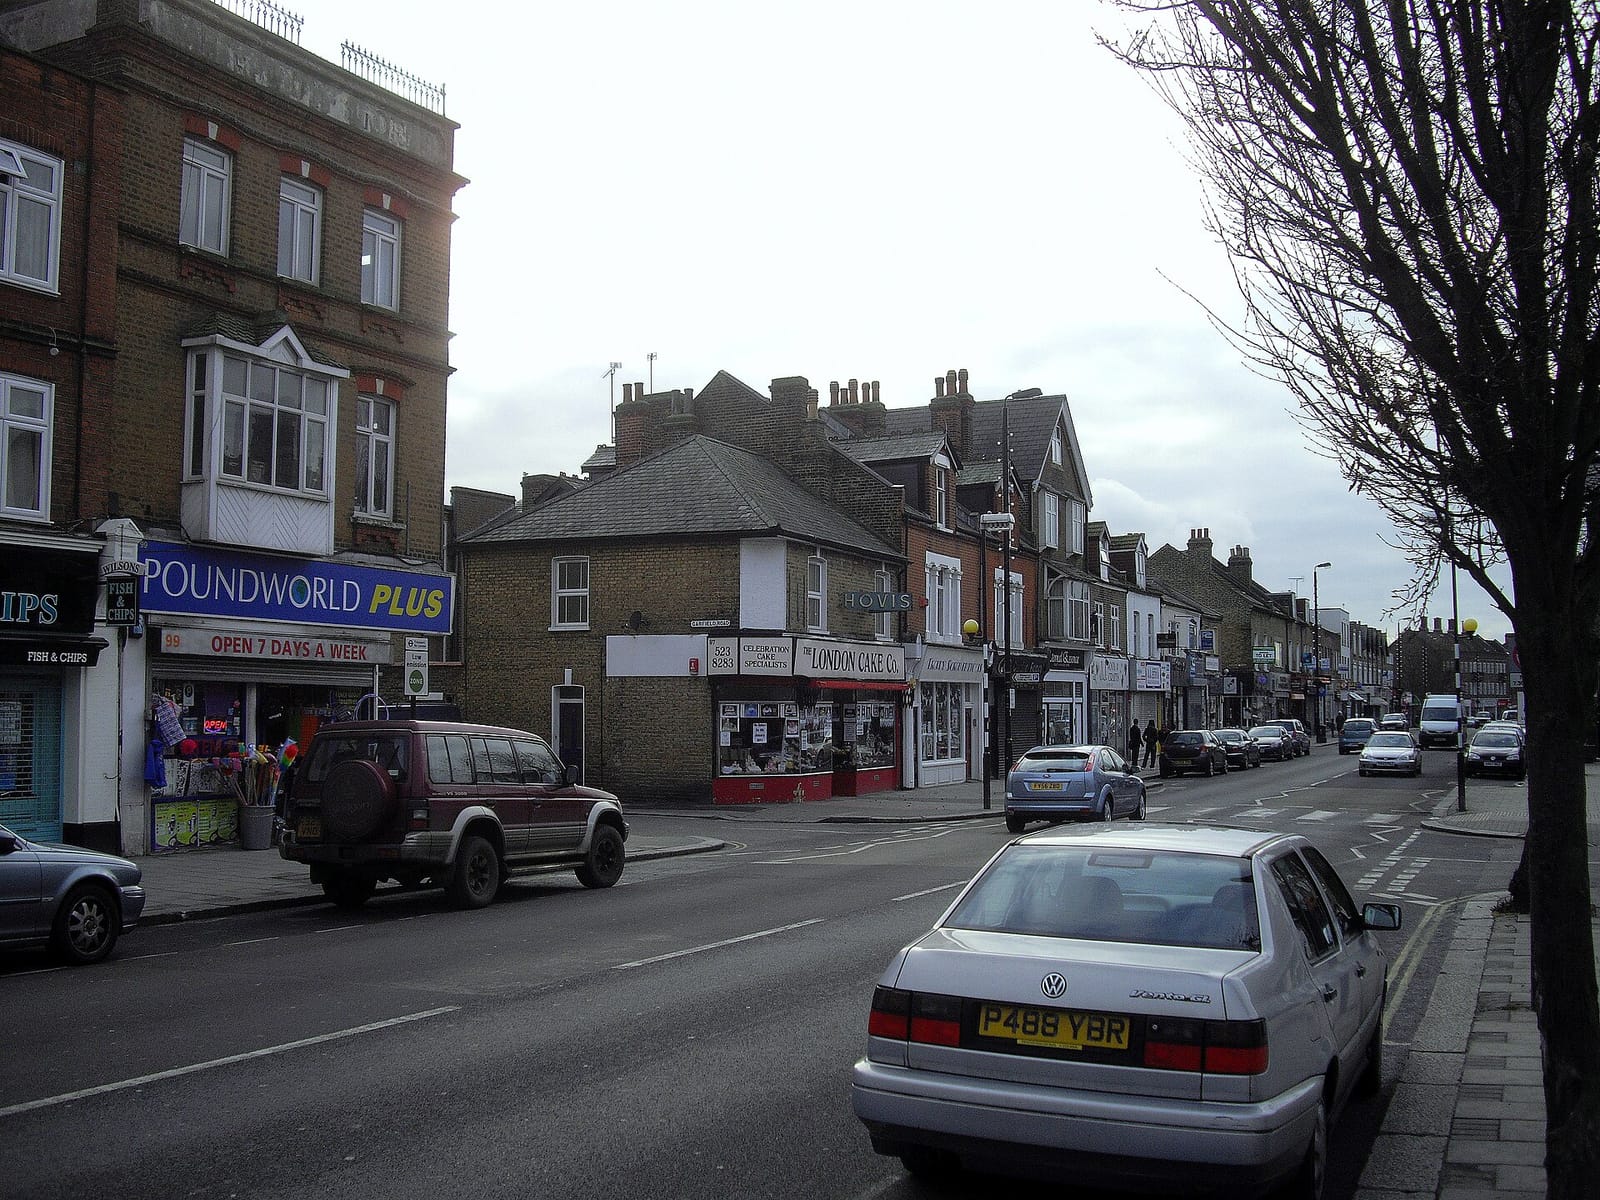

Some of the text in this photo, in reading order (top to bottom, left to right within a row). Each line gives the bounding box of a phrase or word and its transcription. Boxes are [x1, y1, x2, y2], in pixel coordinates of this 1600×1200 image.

[102, 561, 140, 576] WILSONS
[109, 582, 134, 595] FISH
[144, 558, 444, 618] POUNDWORLD PLUS
[116, 595, 125, 608] &
[845, 594, 910, 608] HOVIS
[108, 608, 135, 621] CHIPS
[165, 634, 181, 648] 99
[211, 635, 367, 660] OPEN 7 DAYS A WEEK
[715, 646, 731, 657] 523
[743, 645, 790, 653] CELEBRATION
[28, 651, 87, 663] FISH & CHIPS
[712, 658, 734, 668] 8283
[803, 647, 812, 655] THE
[812, 648, 855, 671] LONDON
[858, 652, 883, 673] CAKE
[744, 660, 787, 668] SPECIALISTS
[204, 720, 227, 730] OPEN
[983, 1006, 1126, 1045] P488 YBR
